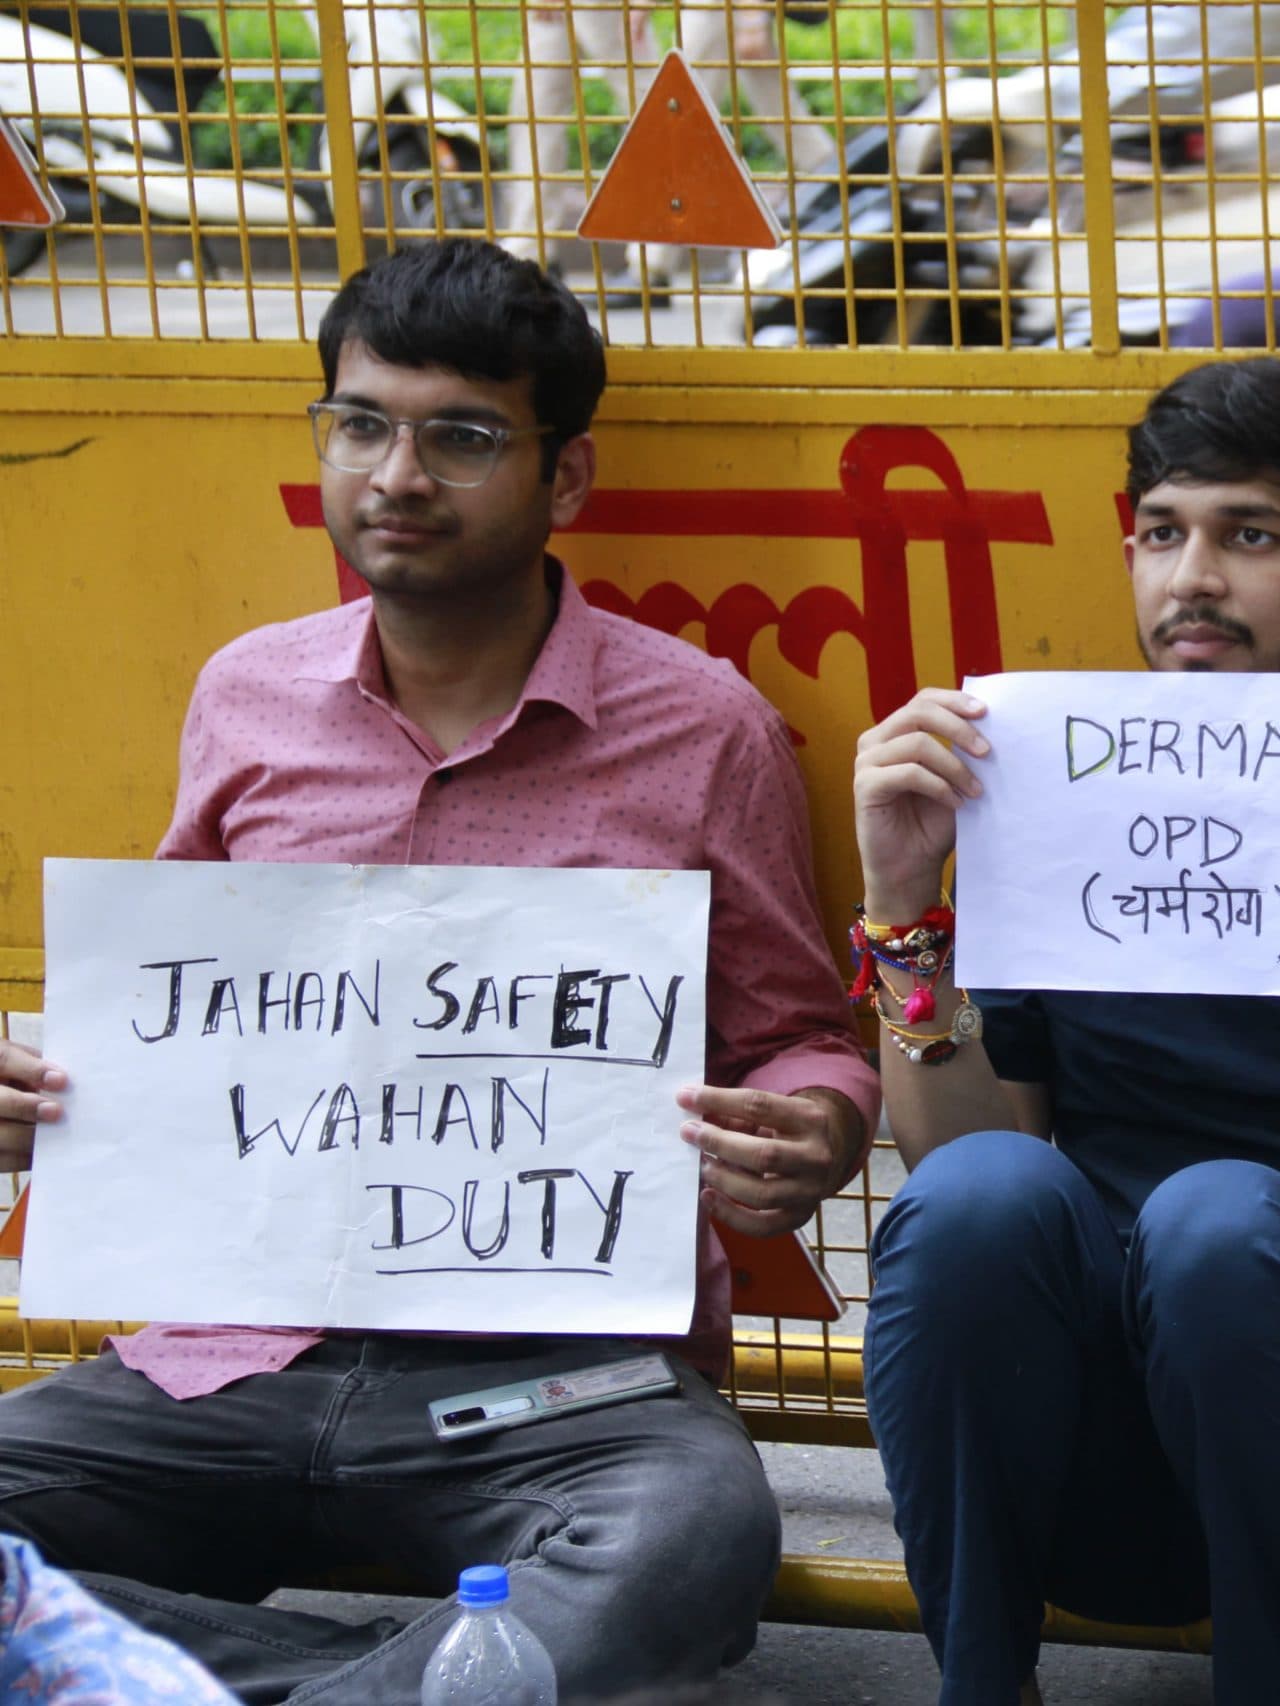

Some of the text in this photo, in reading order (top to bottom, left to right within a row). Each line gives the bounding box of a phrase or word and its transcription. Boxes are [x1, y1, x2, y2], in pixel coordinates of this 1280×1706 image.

[1129, 812, 1243, 868] OPD
[132, 957, 685, 1067] JAHAN SAFETY
[229, 1067, 549, 1160] WAHAN
[366, 1168, 635, 1264] DUTY
